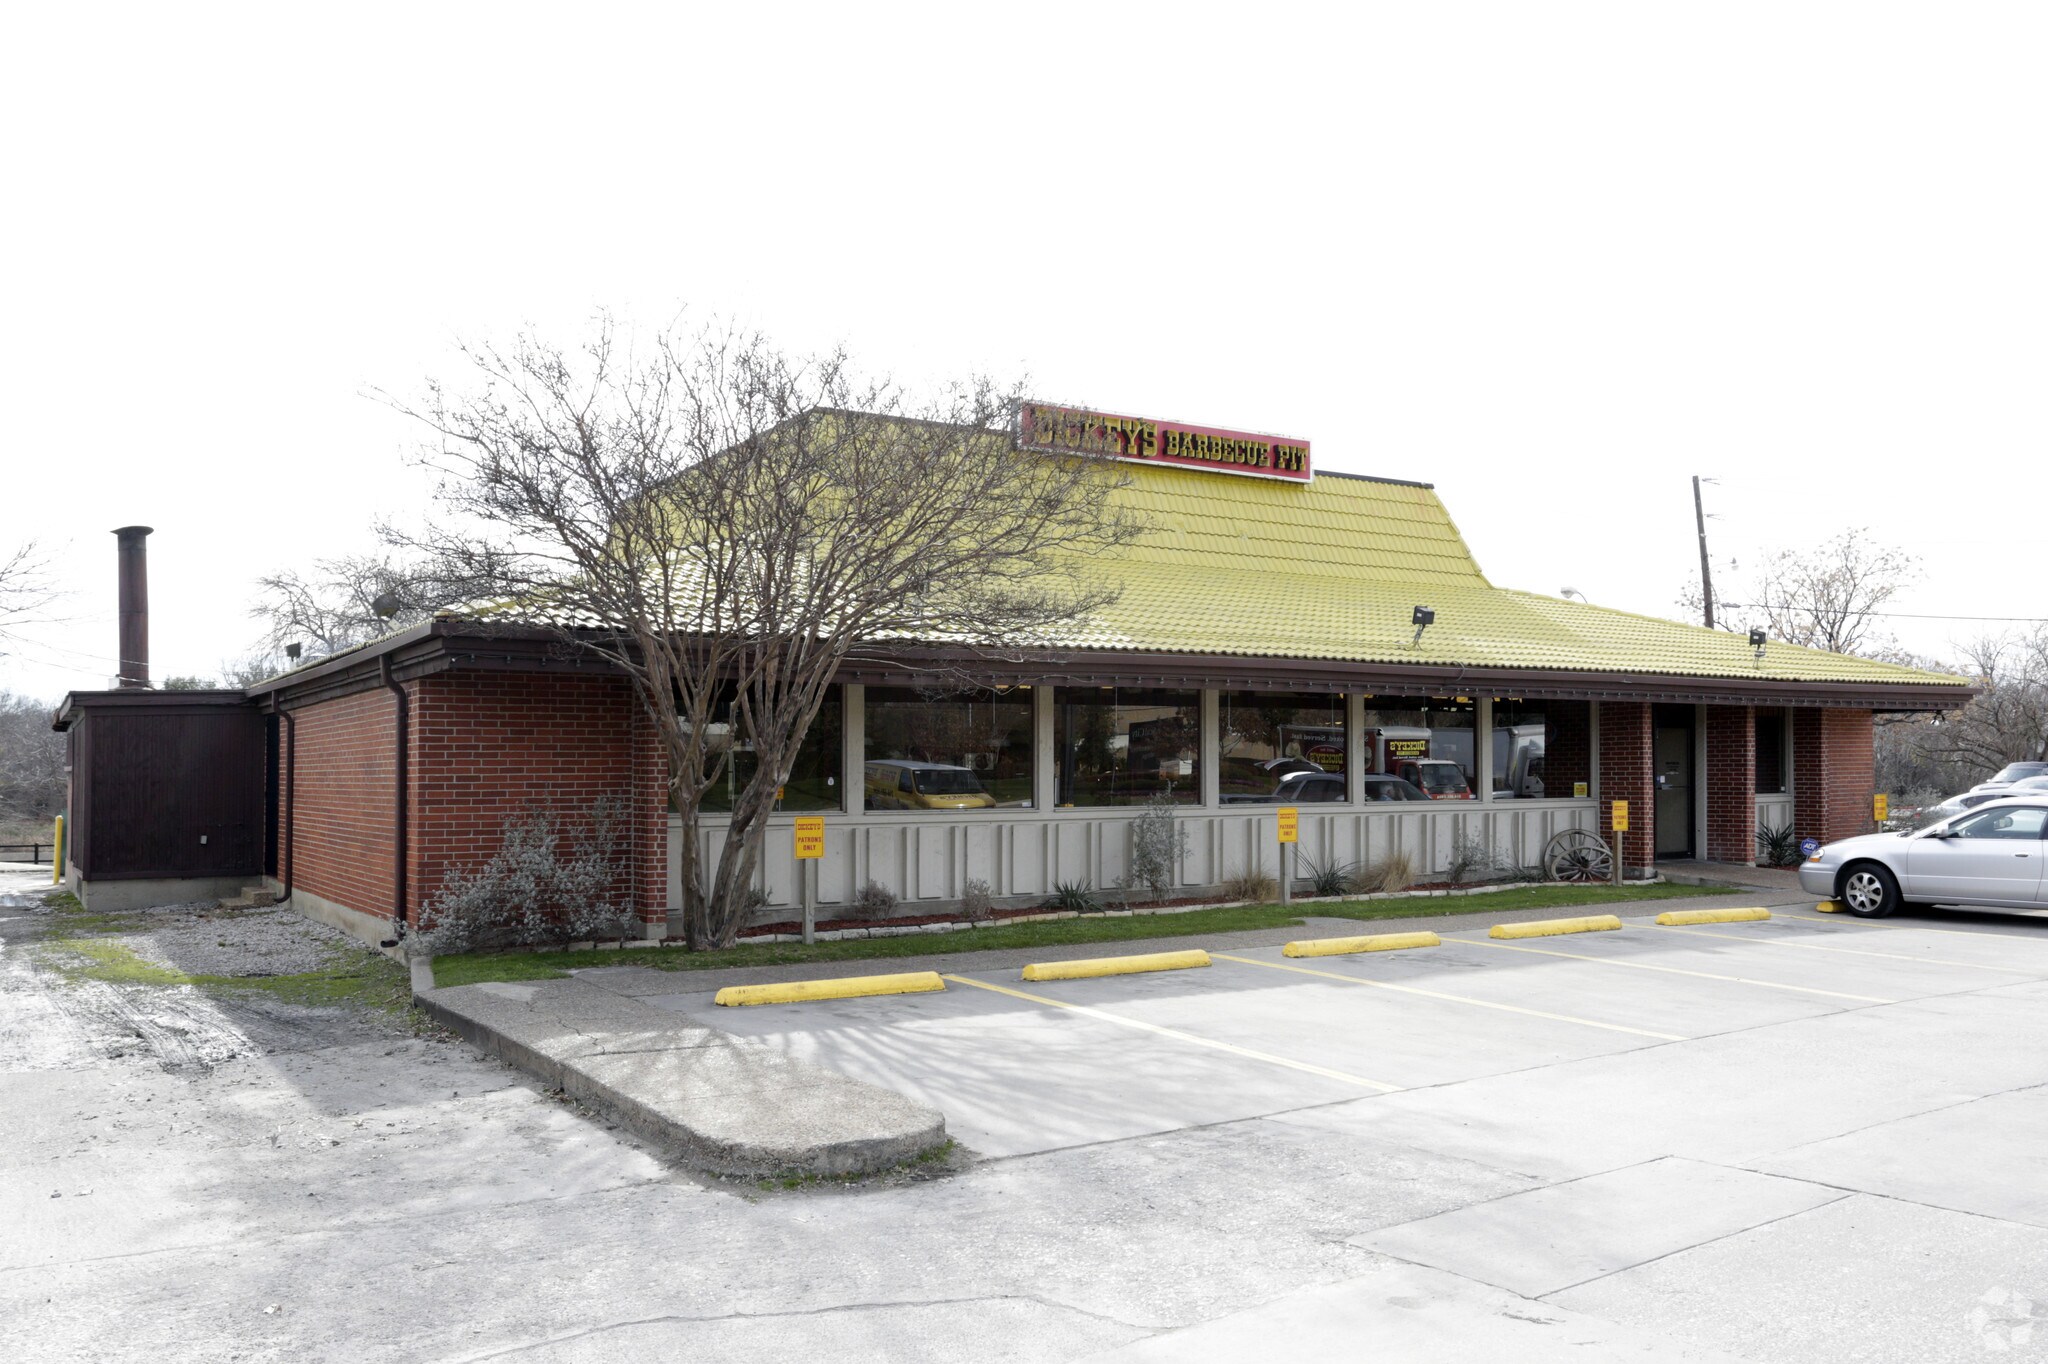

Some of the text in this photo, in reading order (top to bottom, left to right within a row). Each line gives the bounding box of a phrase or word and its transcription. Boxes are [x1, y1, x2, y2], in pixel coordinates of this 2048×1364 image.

[1030, 404, 1309, 472] DICKEY'S BARBECUE PIT
[1803, 842, 1817, 850] ADT
